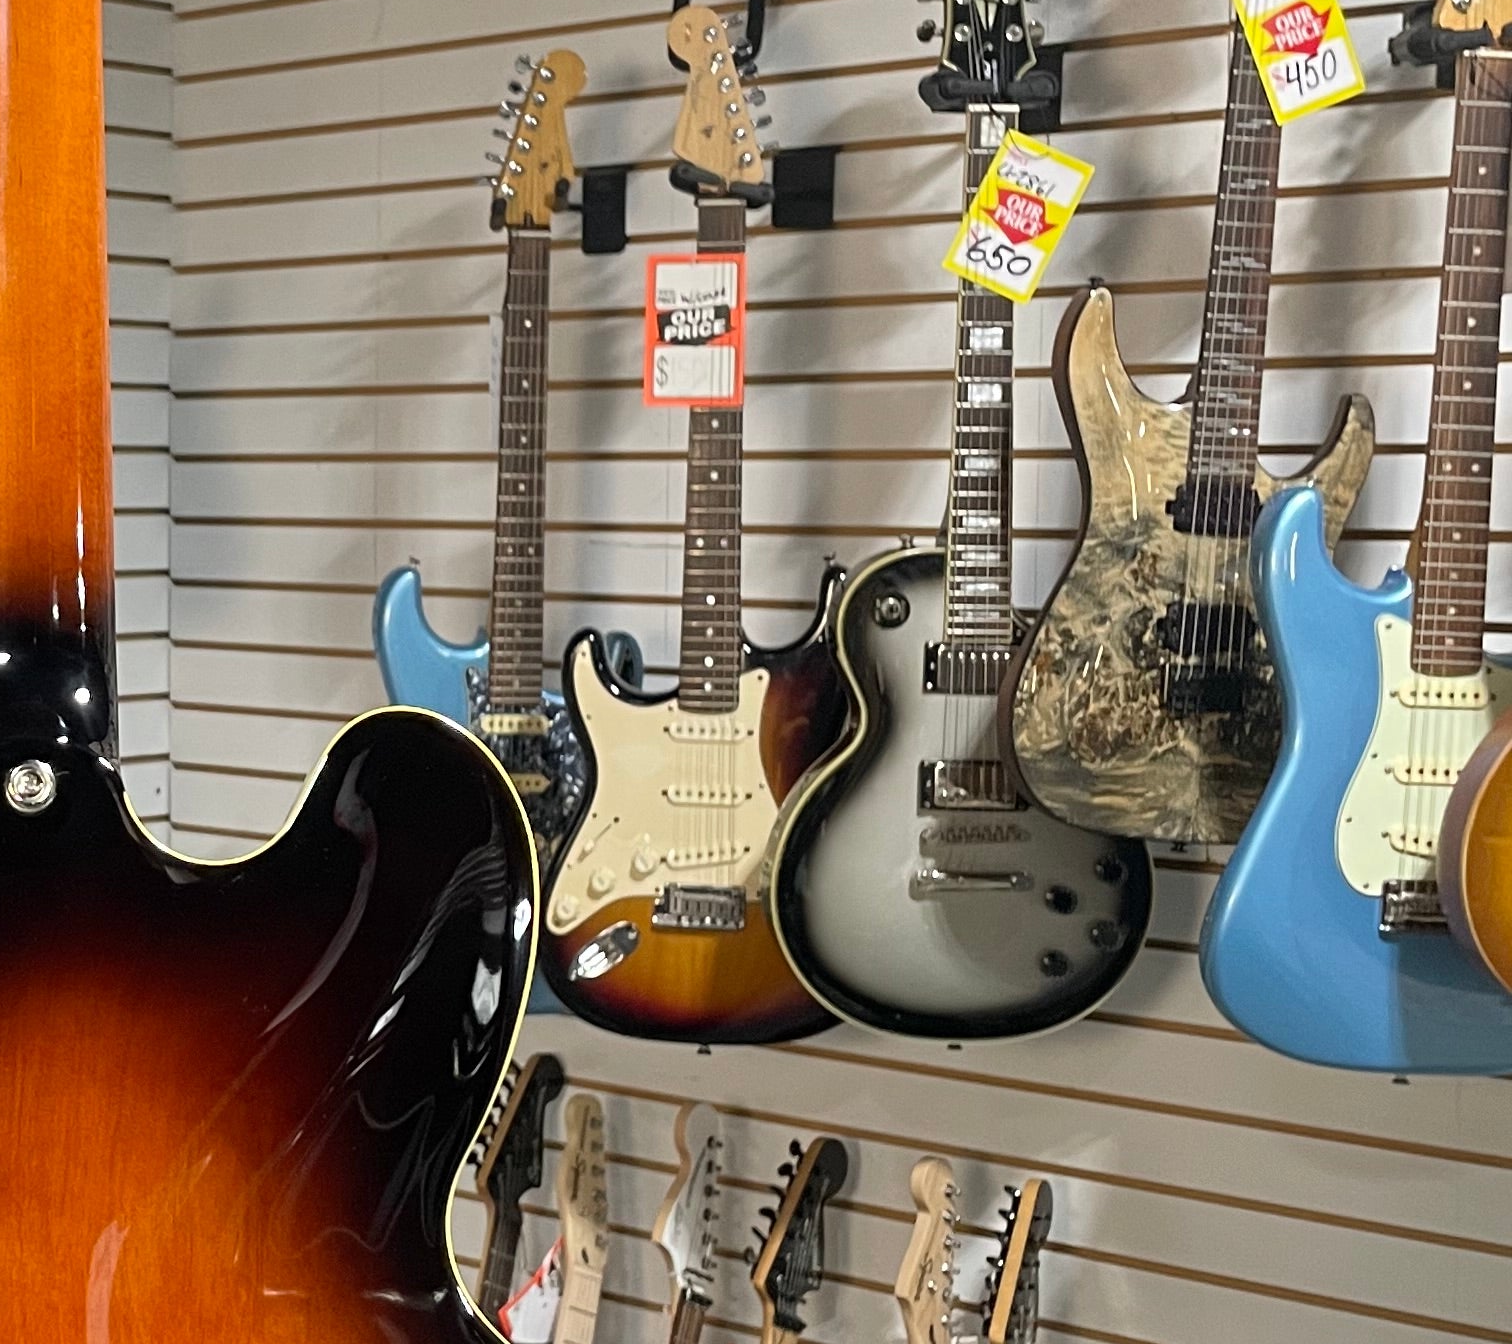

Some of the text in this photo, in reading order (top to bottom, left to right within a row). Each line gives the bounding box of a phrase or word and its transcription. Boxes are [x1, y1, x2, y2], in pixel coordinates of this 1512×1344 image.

[1274, 4, 1314, 32] OUR
[1273, 16, 1324, 53] PRICE
[993, 204, 1045, 237] PRICE
[1005, 193, 1045, 221] OUR
[663, 317, 726, 343] PRICE
[670, 307, 715, 327] OUR
